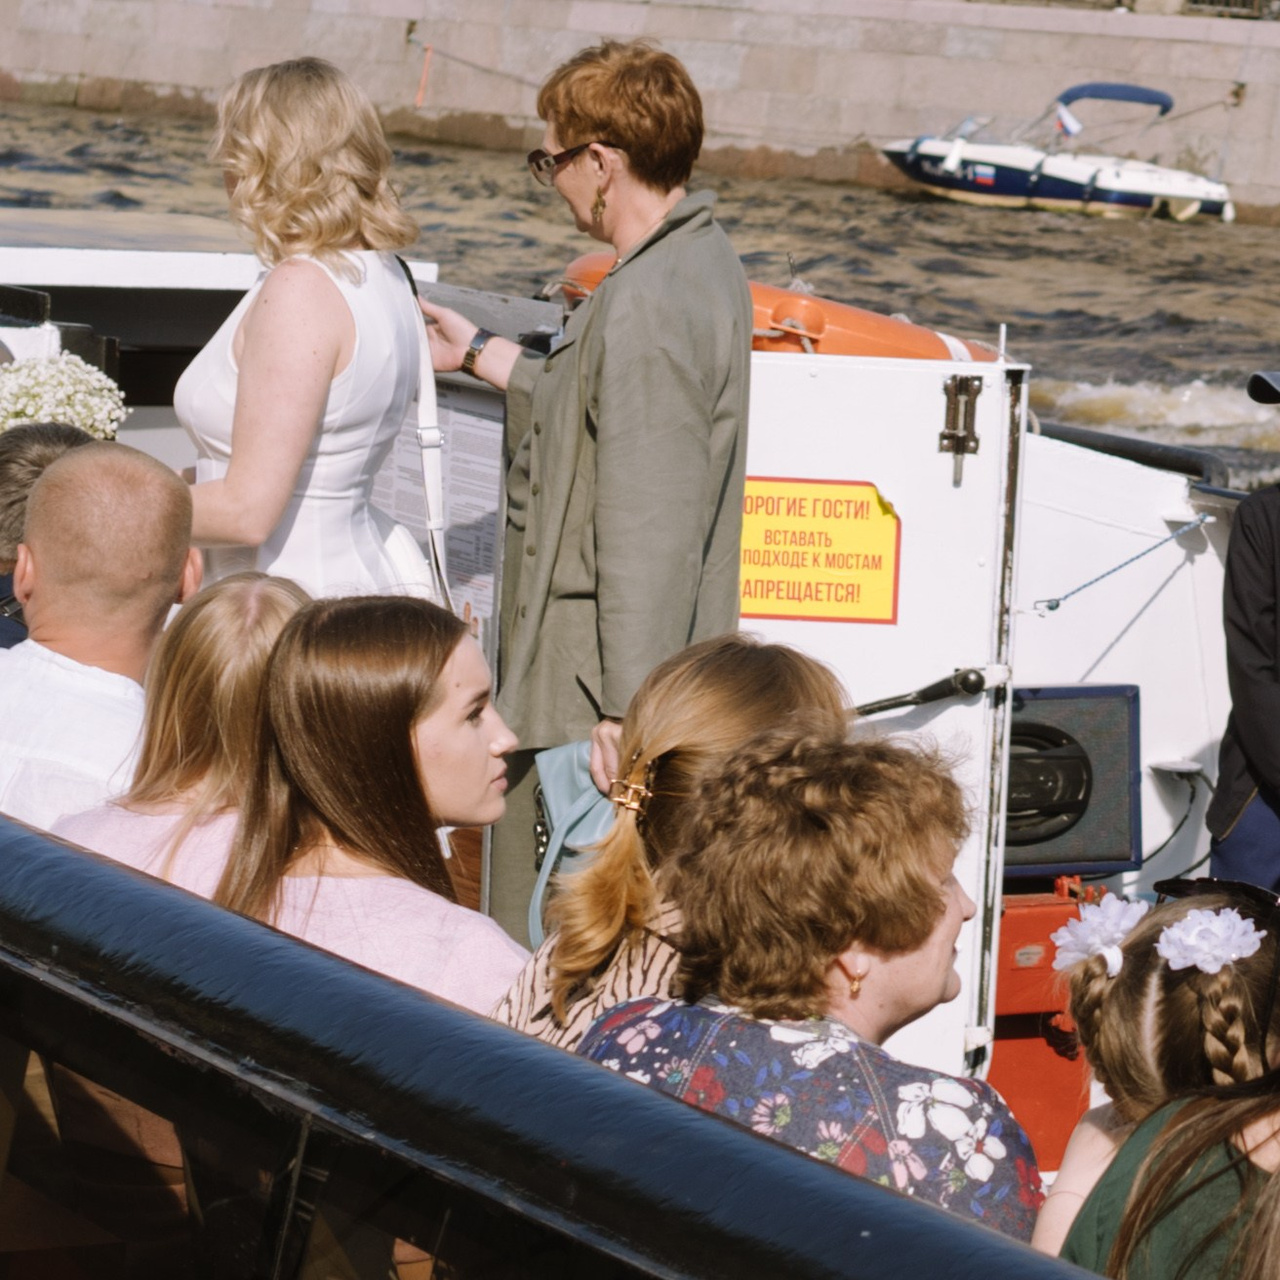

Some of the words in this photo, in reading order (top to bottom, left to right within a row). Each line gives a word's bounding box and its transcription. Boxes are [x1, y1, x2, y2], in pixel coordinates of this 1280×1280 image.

[743, 495, 808, 517] ОРОГИЕ
[812, 498, 870, 520] ГОСТИ!
[764, 529, 832, 548] ВСТАВАТЬ
[743, 549, 808, 568] ПОДХОДЕ
[812, 553, 820, 567] К
[825, 553, 882, 570] МОСТАМ
[740, 579, 861, 603] АПРЕЩАЕТСЯ!
